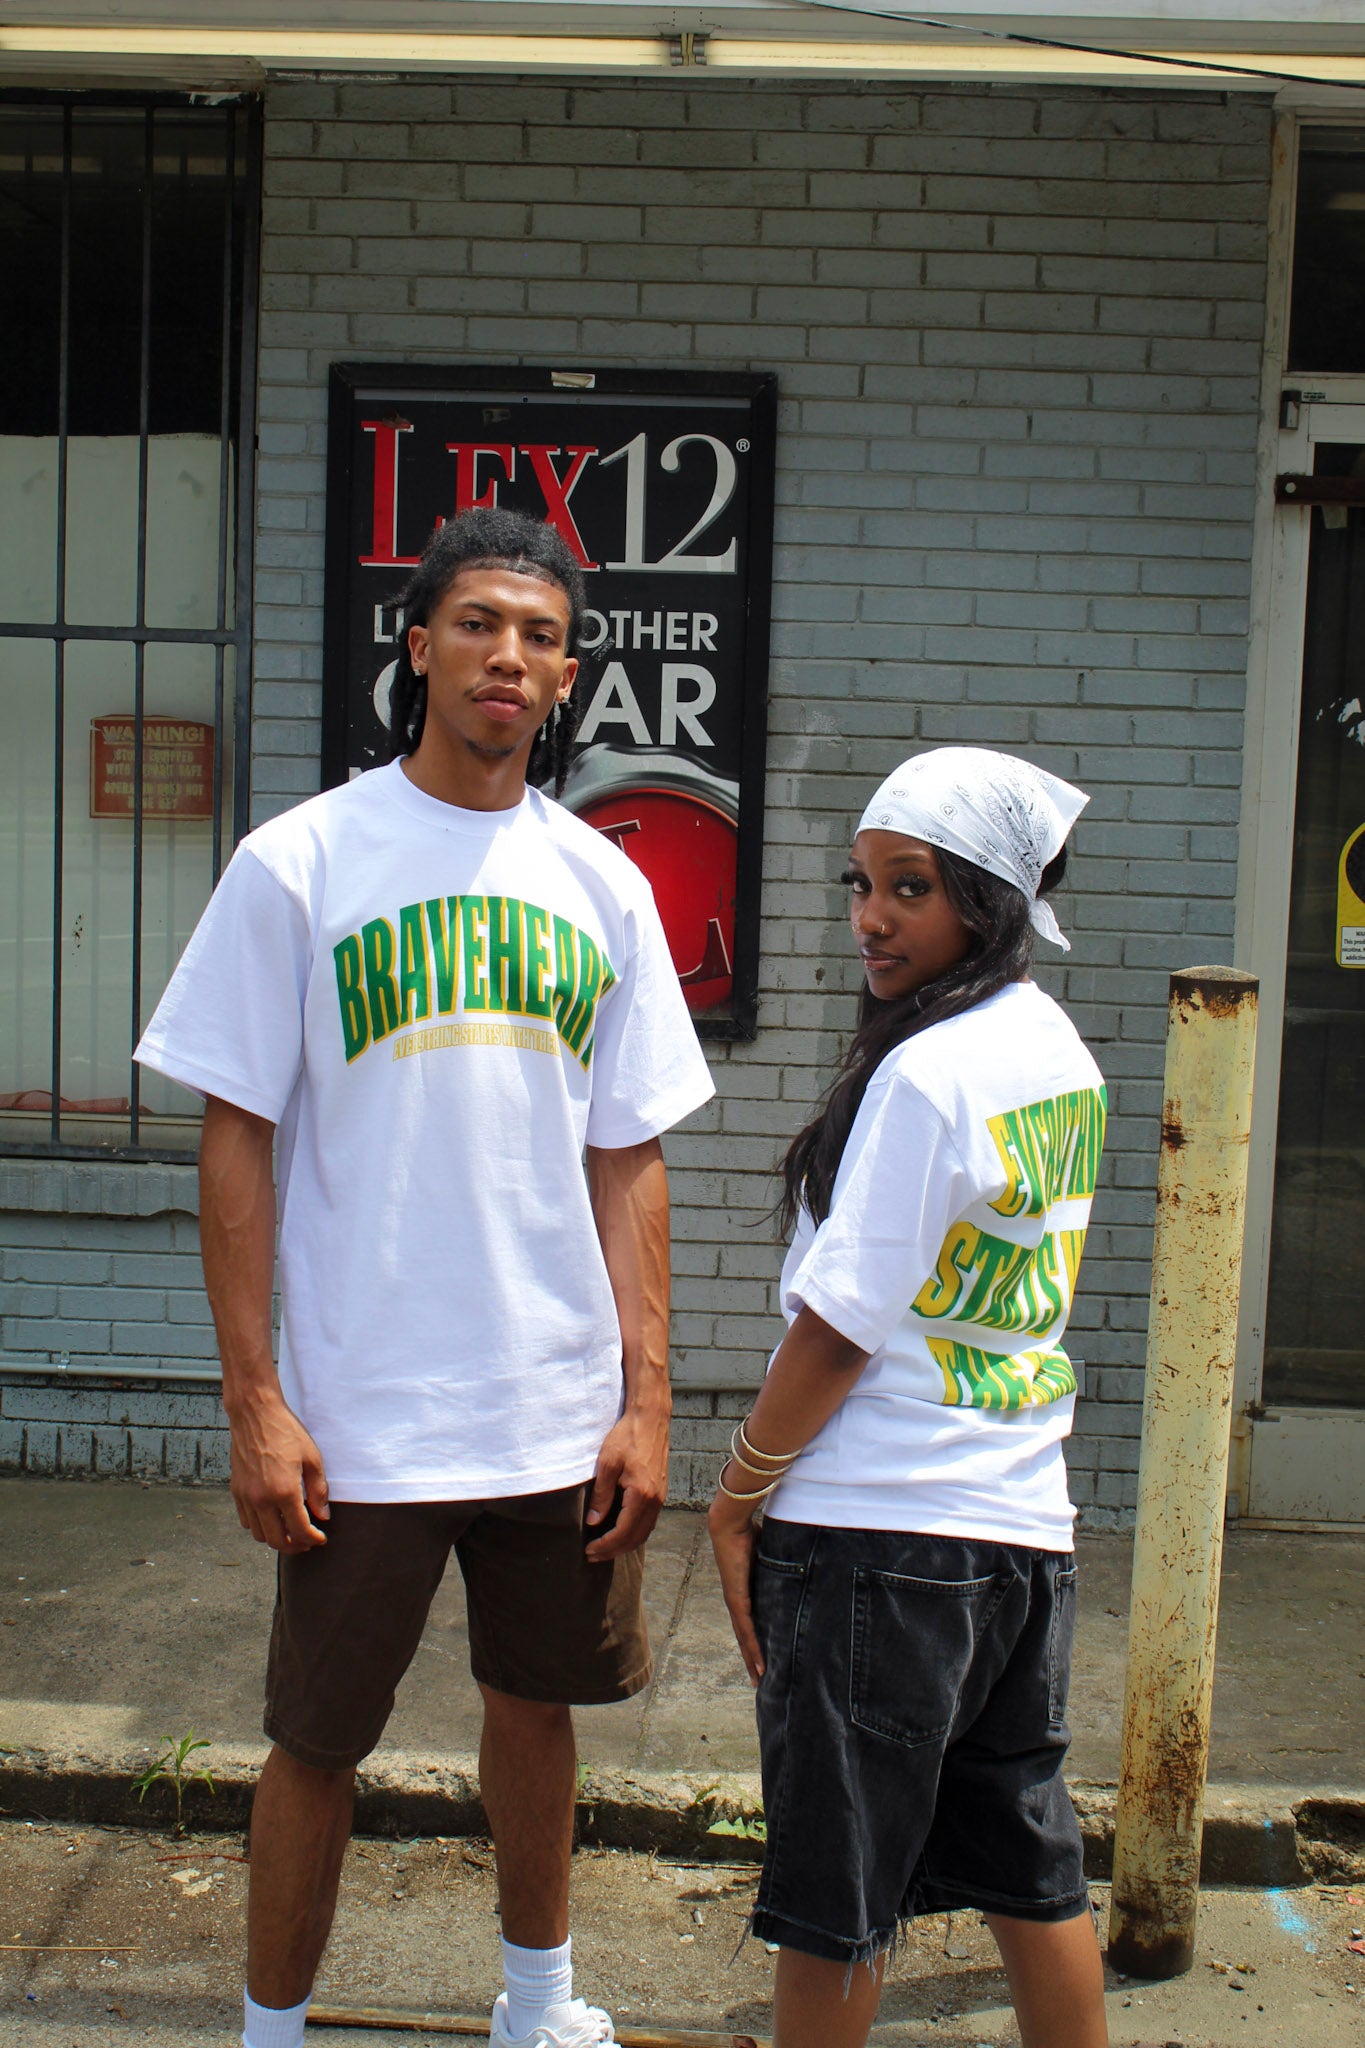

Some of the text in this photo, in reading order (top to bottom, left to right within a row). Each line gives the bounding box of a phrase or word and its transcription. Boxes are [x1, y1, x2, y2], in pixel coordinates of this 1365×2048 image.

[102, 725, 206, 743] WANING!
[460, 1022, 502, 1047] STARTS
[501, 1024, 532, 1050] WITH
